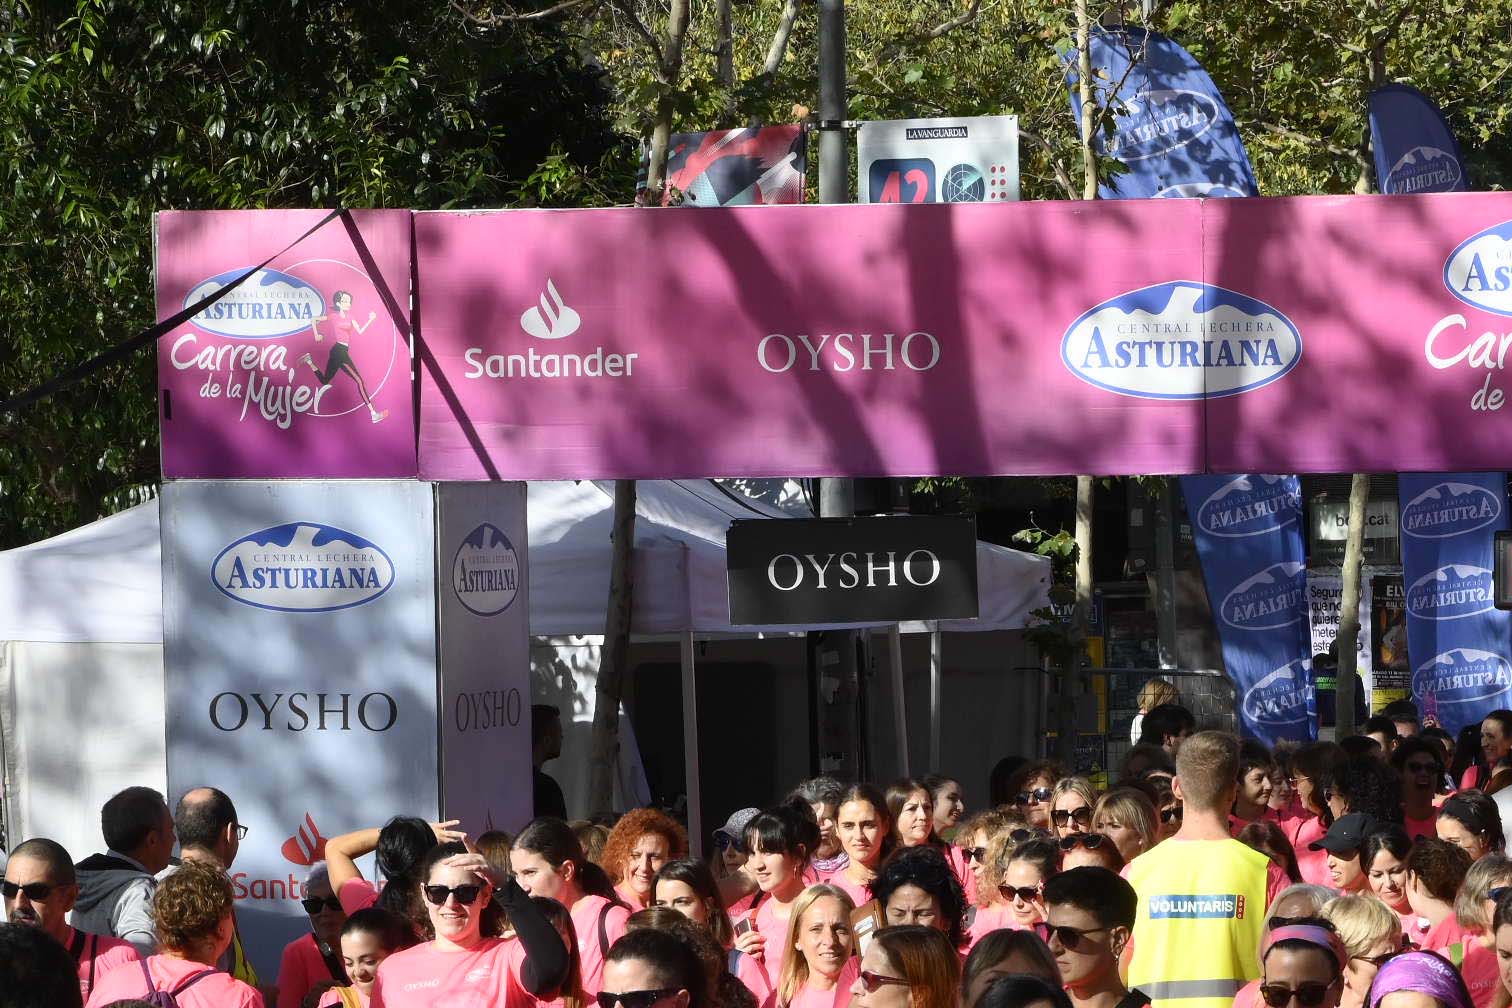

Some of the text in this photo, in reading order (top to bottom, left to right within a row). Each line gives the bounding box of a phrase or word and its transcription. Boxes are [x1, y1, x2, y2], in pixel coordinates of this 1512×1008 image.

[907, 128, 967, 138] LA VANGUARDIA
[194, 294, 313, 321] ASTURIANA
[1117, 320, 1275, 333] CENTRAL LECHERA
[170, 332, 289, 371] Carrera
[464, 346, 639, 379] Santander
[757, 331, 940, 373] OYSHO
[1080, 326, 1283, 369] ASTURIANA
[200, 368, 333, 430] de la Mujer
[1470, 372, 1505, 411] de
[225, 555, 382, 591] ASTURIANA
[253, 552, 375, 563] CENTRAL LECHERA
[458, 558, 516, 594] ASTURIANA
[767, 549, 941, 591] OYSHO
[208, 691, 399, 733] OYSHO
[456, 686, 521, 733] OYSHO
[1151, 900, 1234, 913] VOLUNTARIS
